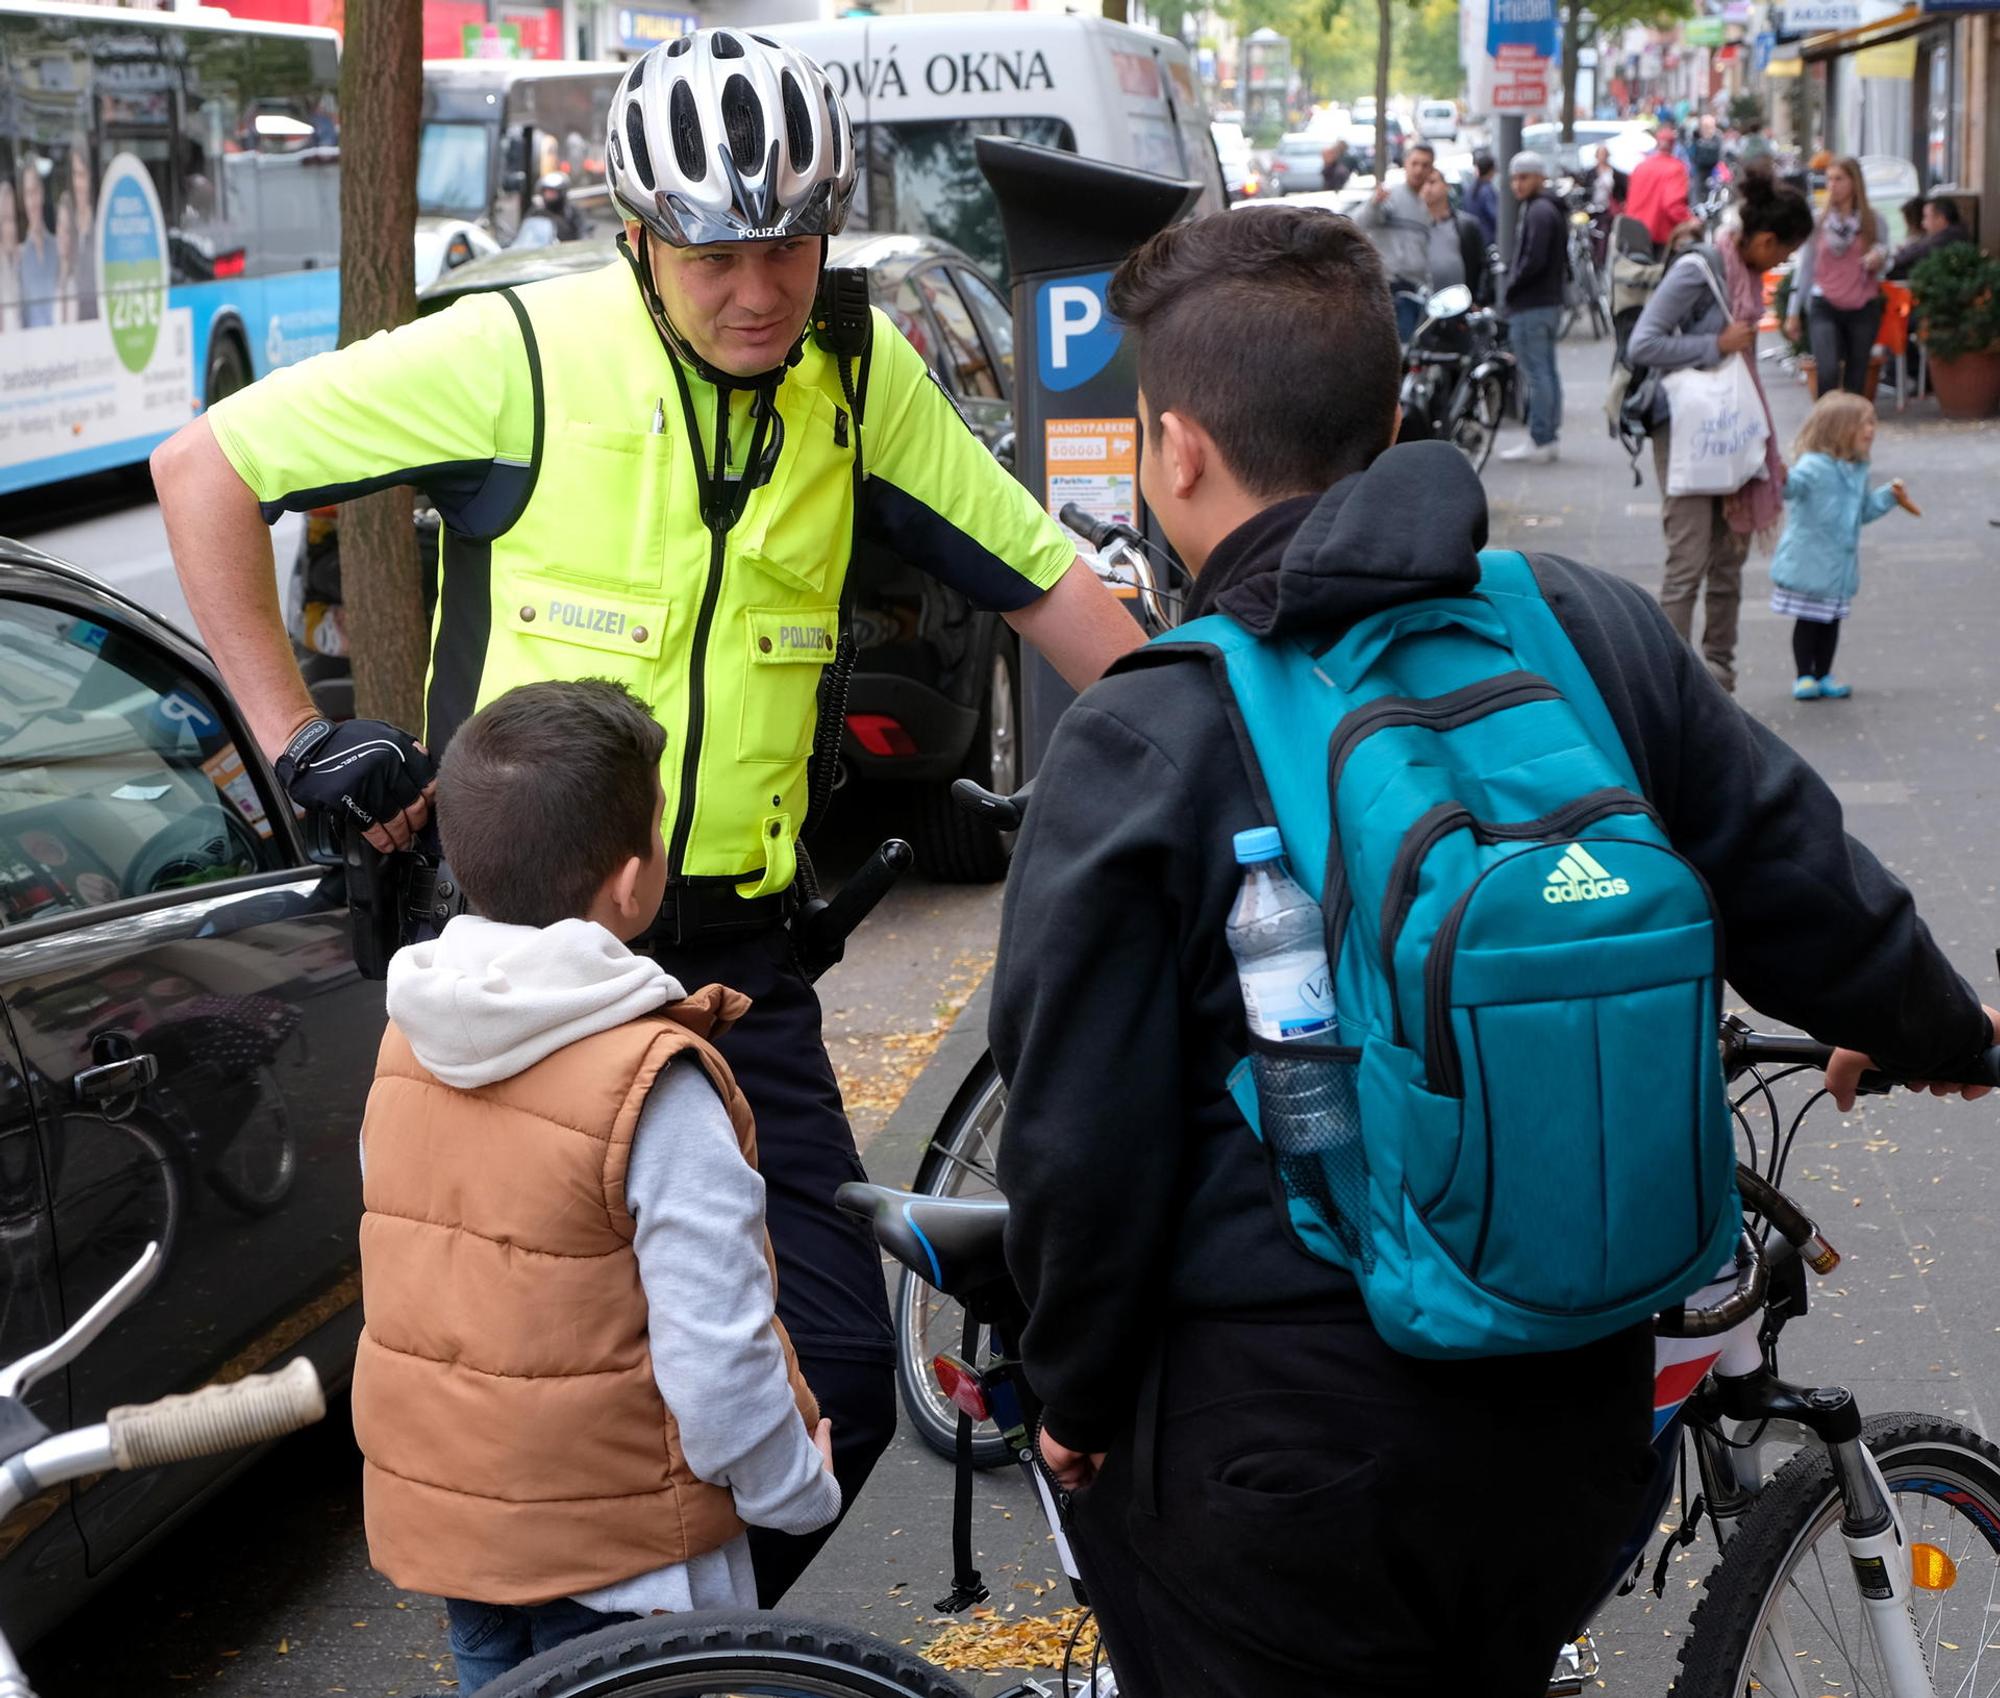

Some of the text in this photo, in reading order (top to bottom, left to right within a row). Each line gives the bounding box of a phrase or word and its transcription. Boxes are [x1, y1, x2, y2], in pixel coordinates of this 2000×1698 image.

[925, 49, 1055, 96] OKNA
[737, 227, 786, 239] POLIZEI
[1048, 286, 1102, 369] P
[1048, 423, 1135, 435] HANDYPARKEN
[548, 600, 626, 636] POLIZEI
[780, 626, 826, 650] POLIZEI
[1543, 878, 1631, 904] adidas
